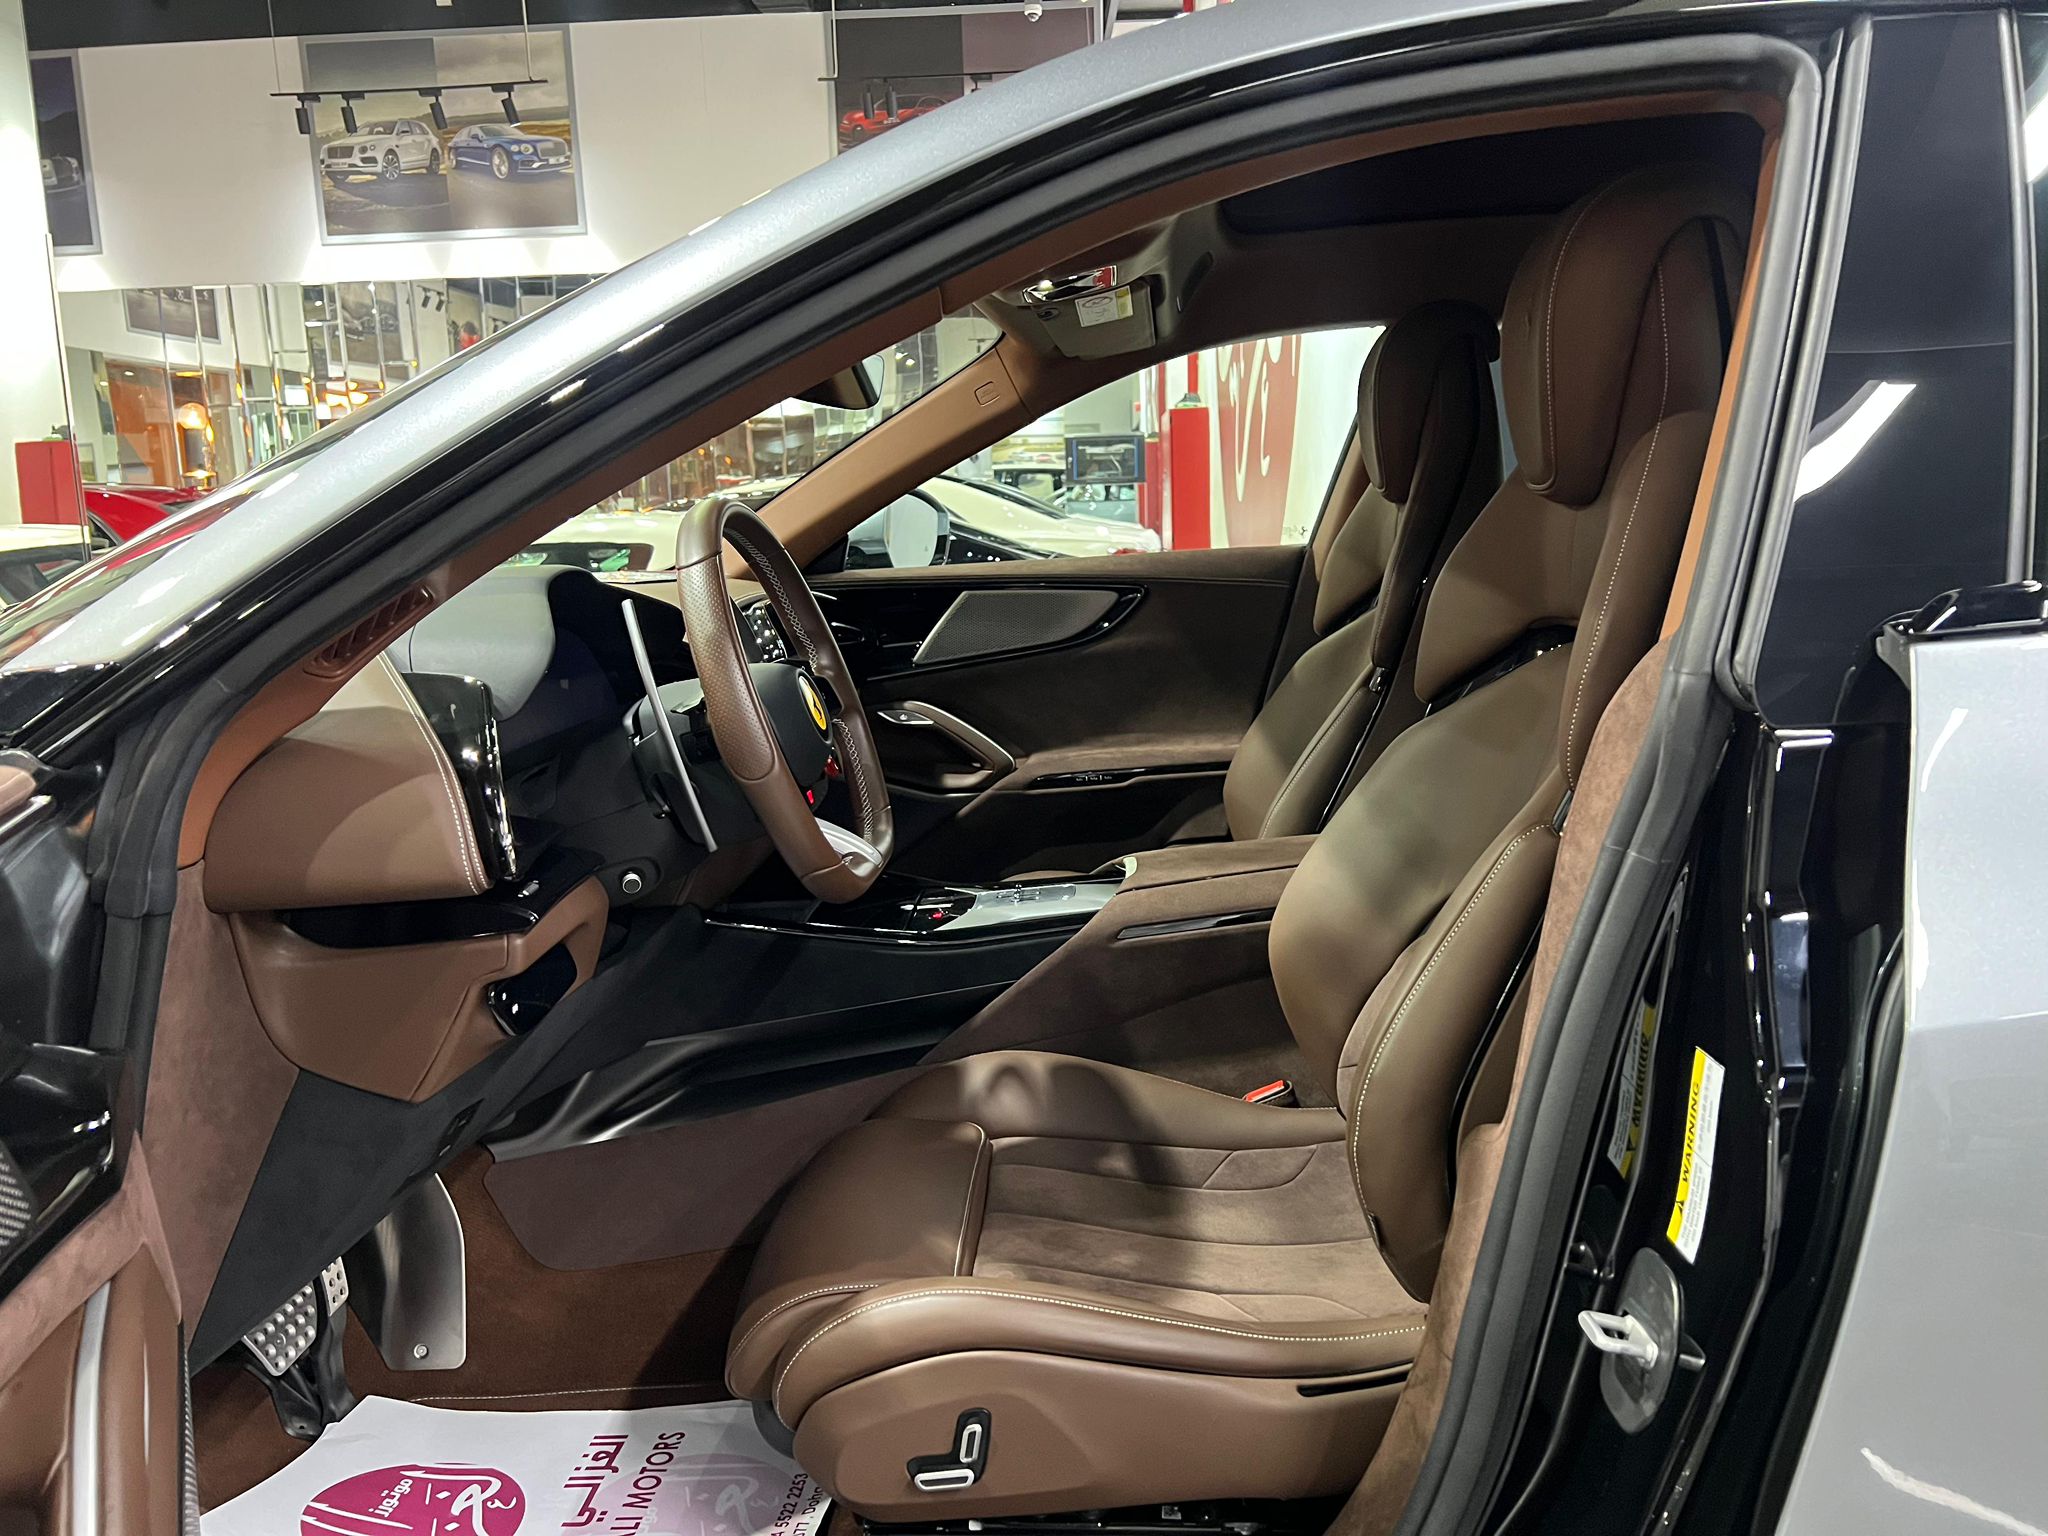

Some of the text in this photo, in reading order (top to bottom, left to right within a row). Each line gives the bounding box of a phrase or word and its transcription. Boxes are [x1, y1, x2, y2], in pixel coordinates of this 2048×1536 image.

[1682, 1081, 1700, 1183] WARNING
[368, 1479, 412, 1517] موتورز
[561, 1434, 629, 1528] الغزالي
[622, 1431, 685, 1509] MOTORS
[774, 1501, 798, 1528] 5522
[786, 1472, 809, 1500] 2253
